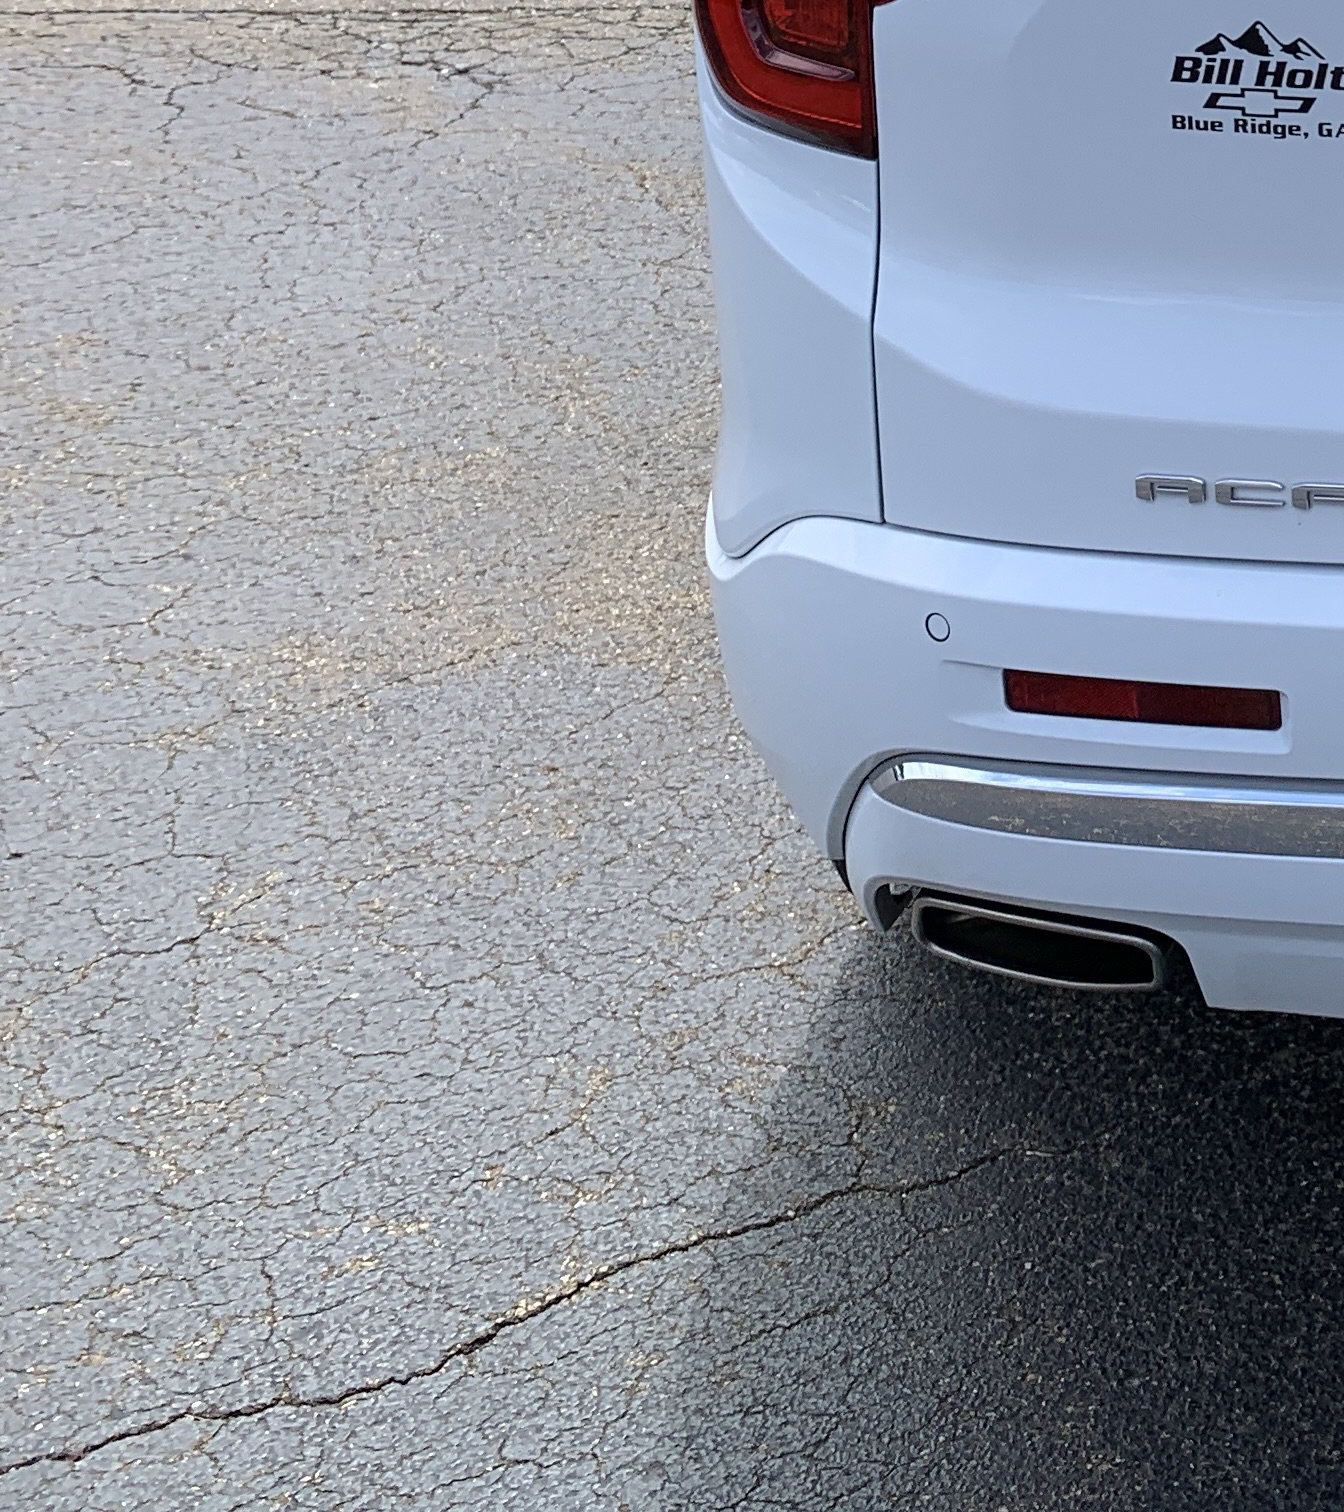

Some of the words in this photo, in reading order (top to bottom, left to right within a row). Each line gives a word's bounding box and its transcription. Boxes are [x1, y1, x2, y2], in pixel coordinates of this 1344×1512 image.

[1169, 56, 1245, 85] Bill
[1171, 115, 1223, 133] Blue
[1233, 118, 1309, 139] Ridge,
